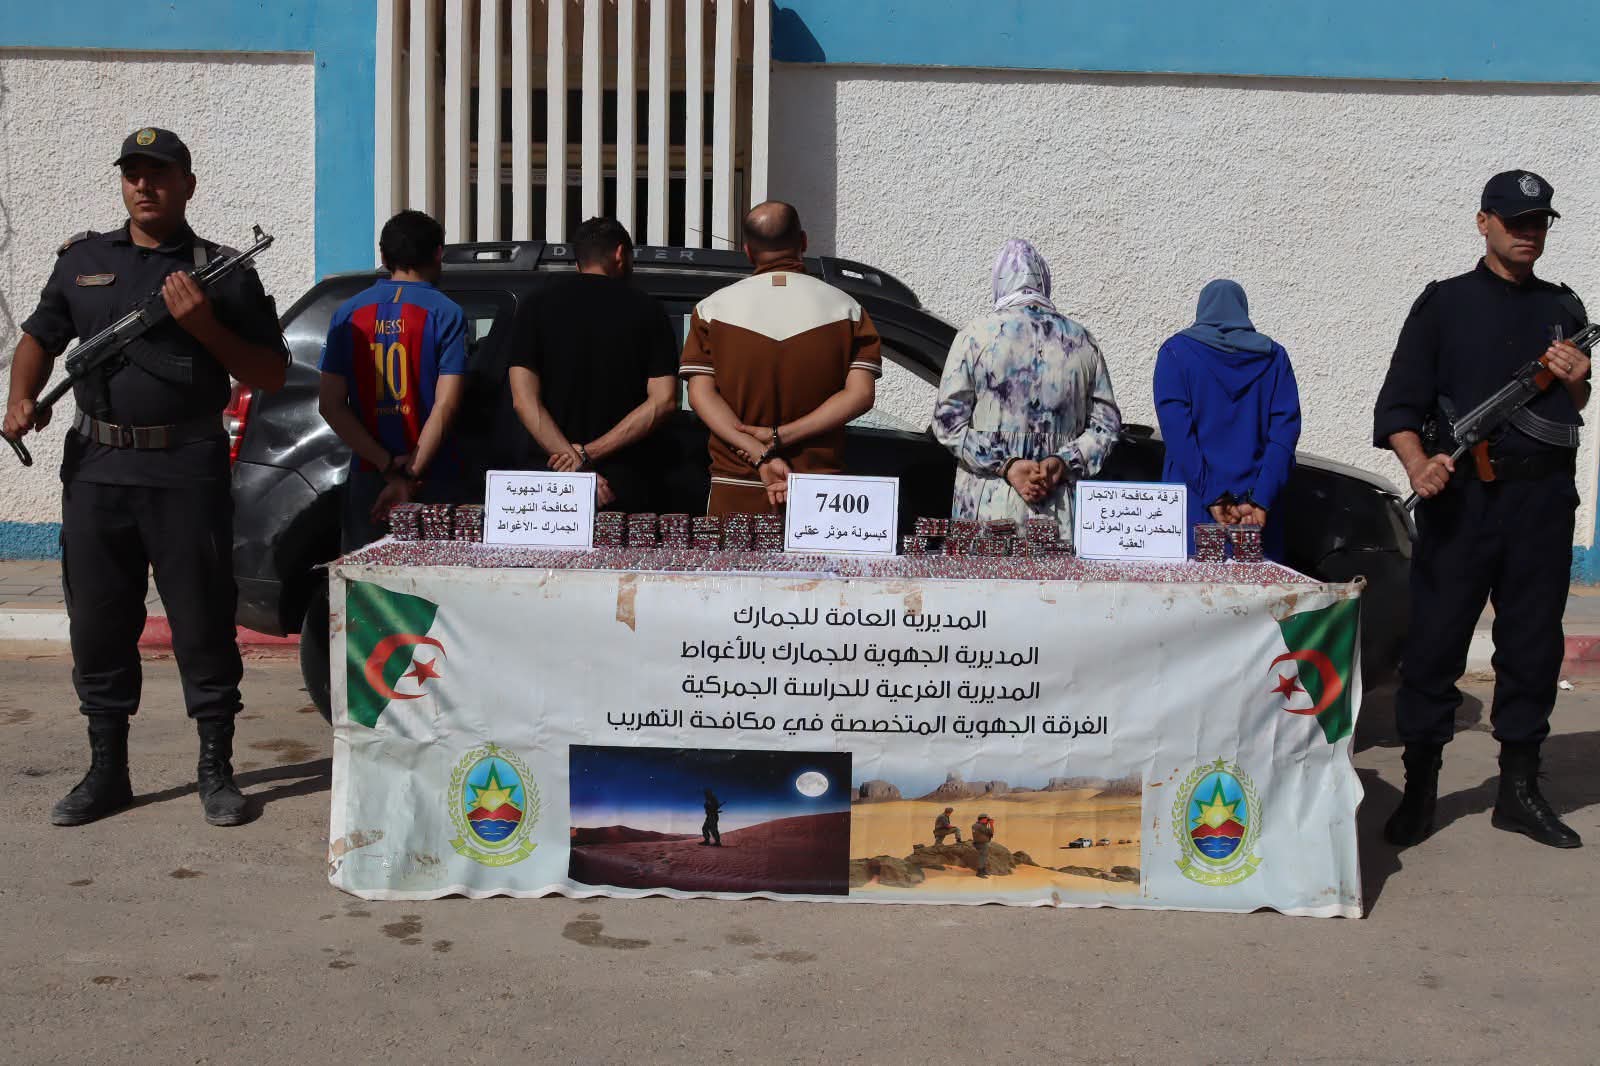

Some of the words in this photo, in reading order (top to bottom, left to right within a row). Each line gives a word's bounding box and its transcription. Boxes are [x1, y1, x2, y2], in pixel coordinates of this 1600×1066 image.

[553, 246, 695, 261] DTER
[375, 319, 405, 335] MESSI
[370, 342, 407, 400] 10
[506, 481, 543, 496] الجهوية
[547, 482, 574, 496] الفرقة
[1088, 489, 1118, 501] الاتجار
[1121, 490, 1154, 501] مكافحة
[1157, 491, 1179, 505] فرقة
[501, 502, 538, 515] التهريب
[541, 501, 578, 513] لمكافحة
[816, 493, 869, 514] 7400
[1100, 506, 1142, 519] المشروع
[1147, 508, 1163, 519] غير
[541, 521, 579, 534] الجمارك
[794, 525, 820, 540] عقلي
[852, 526, 888, 541] كبسولة
[1134, 524, 1182, 536] بالمخدرات
[733, 606, 819, 630] للجمارك
[825, 607, 896, 627] العامة
[902, 609, 987, 632] المديرية
[680, 635, 766, 665] بالأغواط
[772, 642, 857, 666] للجمارك
[864, 644, 949, 667] الجهوية
[955, 646, 1039, 669] المديرية
[681, 674, 777, 700] الجمركية
[784, 677, 869, 702] للحراسة
[876, 679, 951, 703] الفرعية
[957, 681, 1040, 704] المديرية
[607, 709, 683, 731] التهريب
[690, 711, 776, 730] مكافحة
[782, 713, 824, 736] في
[831, 713, 946, 736] المتخصصة
[952, 715, 1035, 739] الجهوية
[1042, 715, 1108, 739] الفرقة
